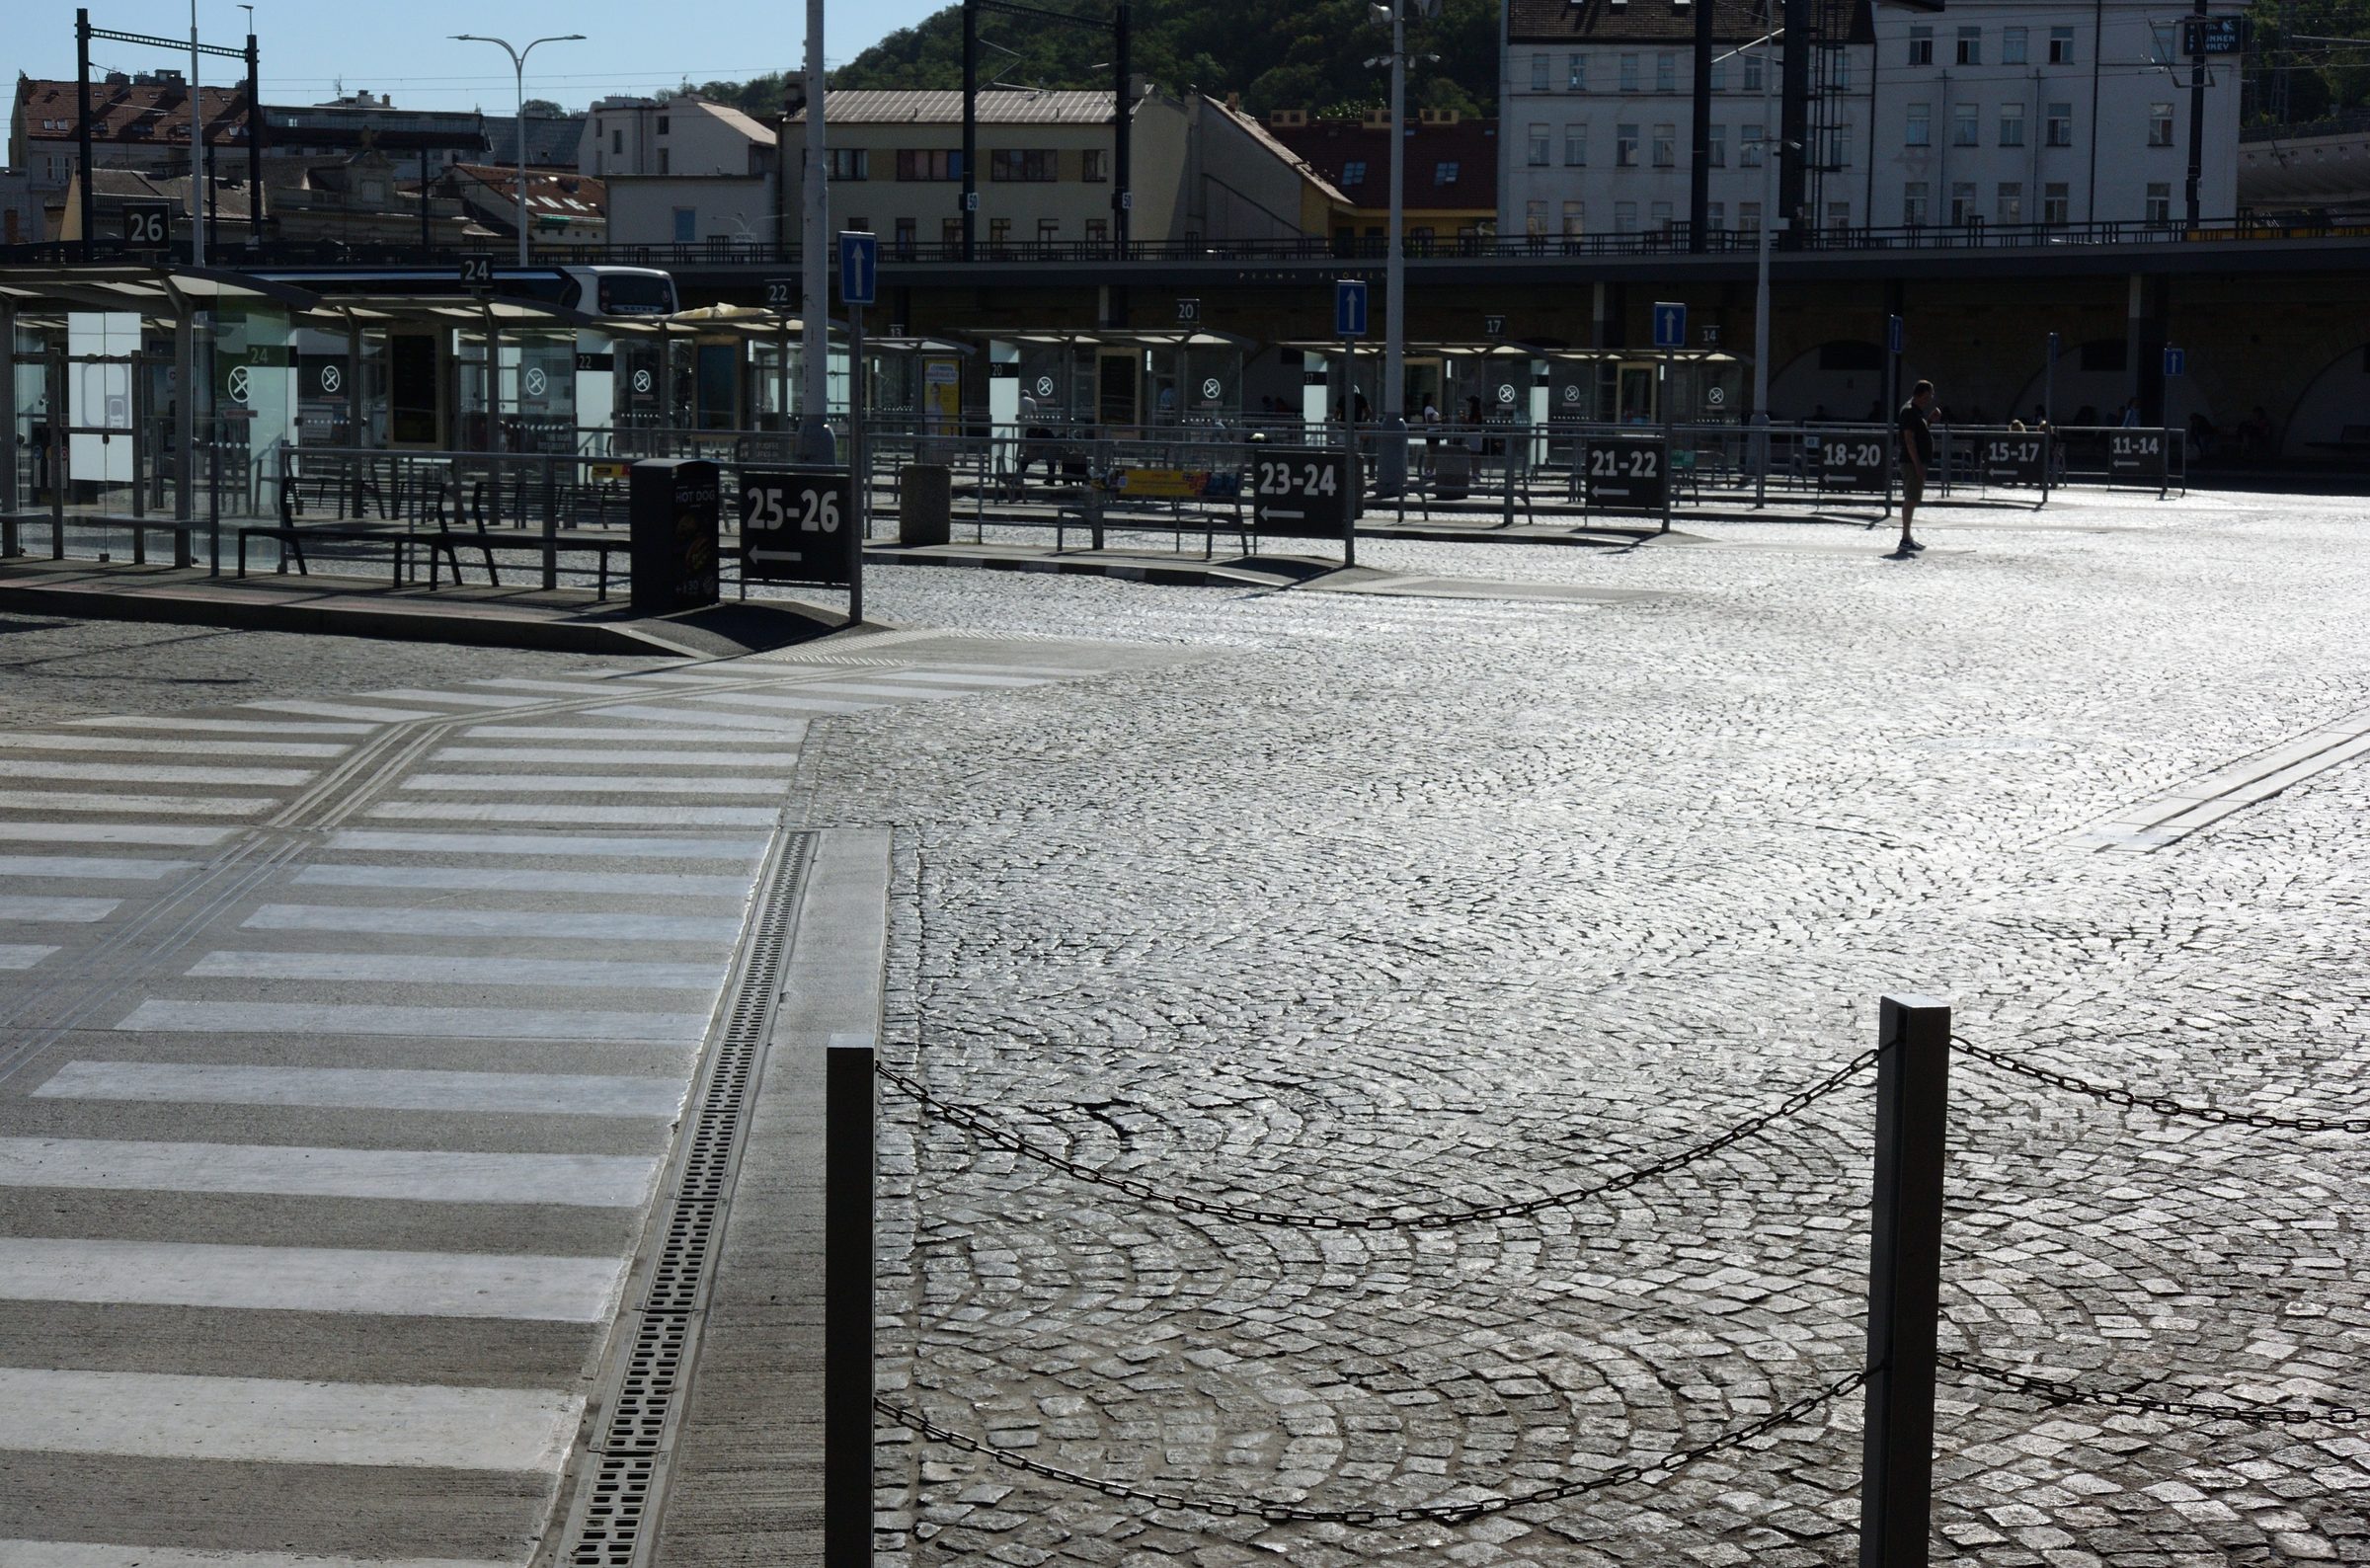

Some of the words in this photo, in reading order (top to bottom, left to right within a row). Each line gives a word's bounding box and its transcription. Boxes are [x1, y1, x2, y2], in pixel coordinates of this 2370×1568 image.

[969, 195, 978, 209] 50
[1124, 195, 1133, 208] 50
[129, 213, 164, 242] 26
[464, 260, 490, 281] 24
[1318, 272, 1387, 280] FLOREN
[768, 284, 789, 301] 22
[1178, 303, 1194, 319] 20
[1487, 320, 1502, 333] 17
[1702, 330, 1717, 342] 14
[250, 347, 269, 364] 24
[579, 354, 592, 369] 22
[991, 363, 1003, 376] 20
[1989, 442, 2040, 463] 15-17
[2113, 436, 2159, 455] 11-14
[1823, 442, 1881, 467] 18-20
[1591, 449, 1658, 478] 21-22
[1259, 461, 1338, 497] 23-24
[675, 492, 694, 504] HOT
[695, 490, 716, 502] DOG
[747, 487, 839, 533] 25-26
